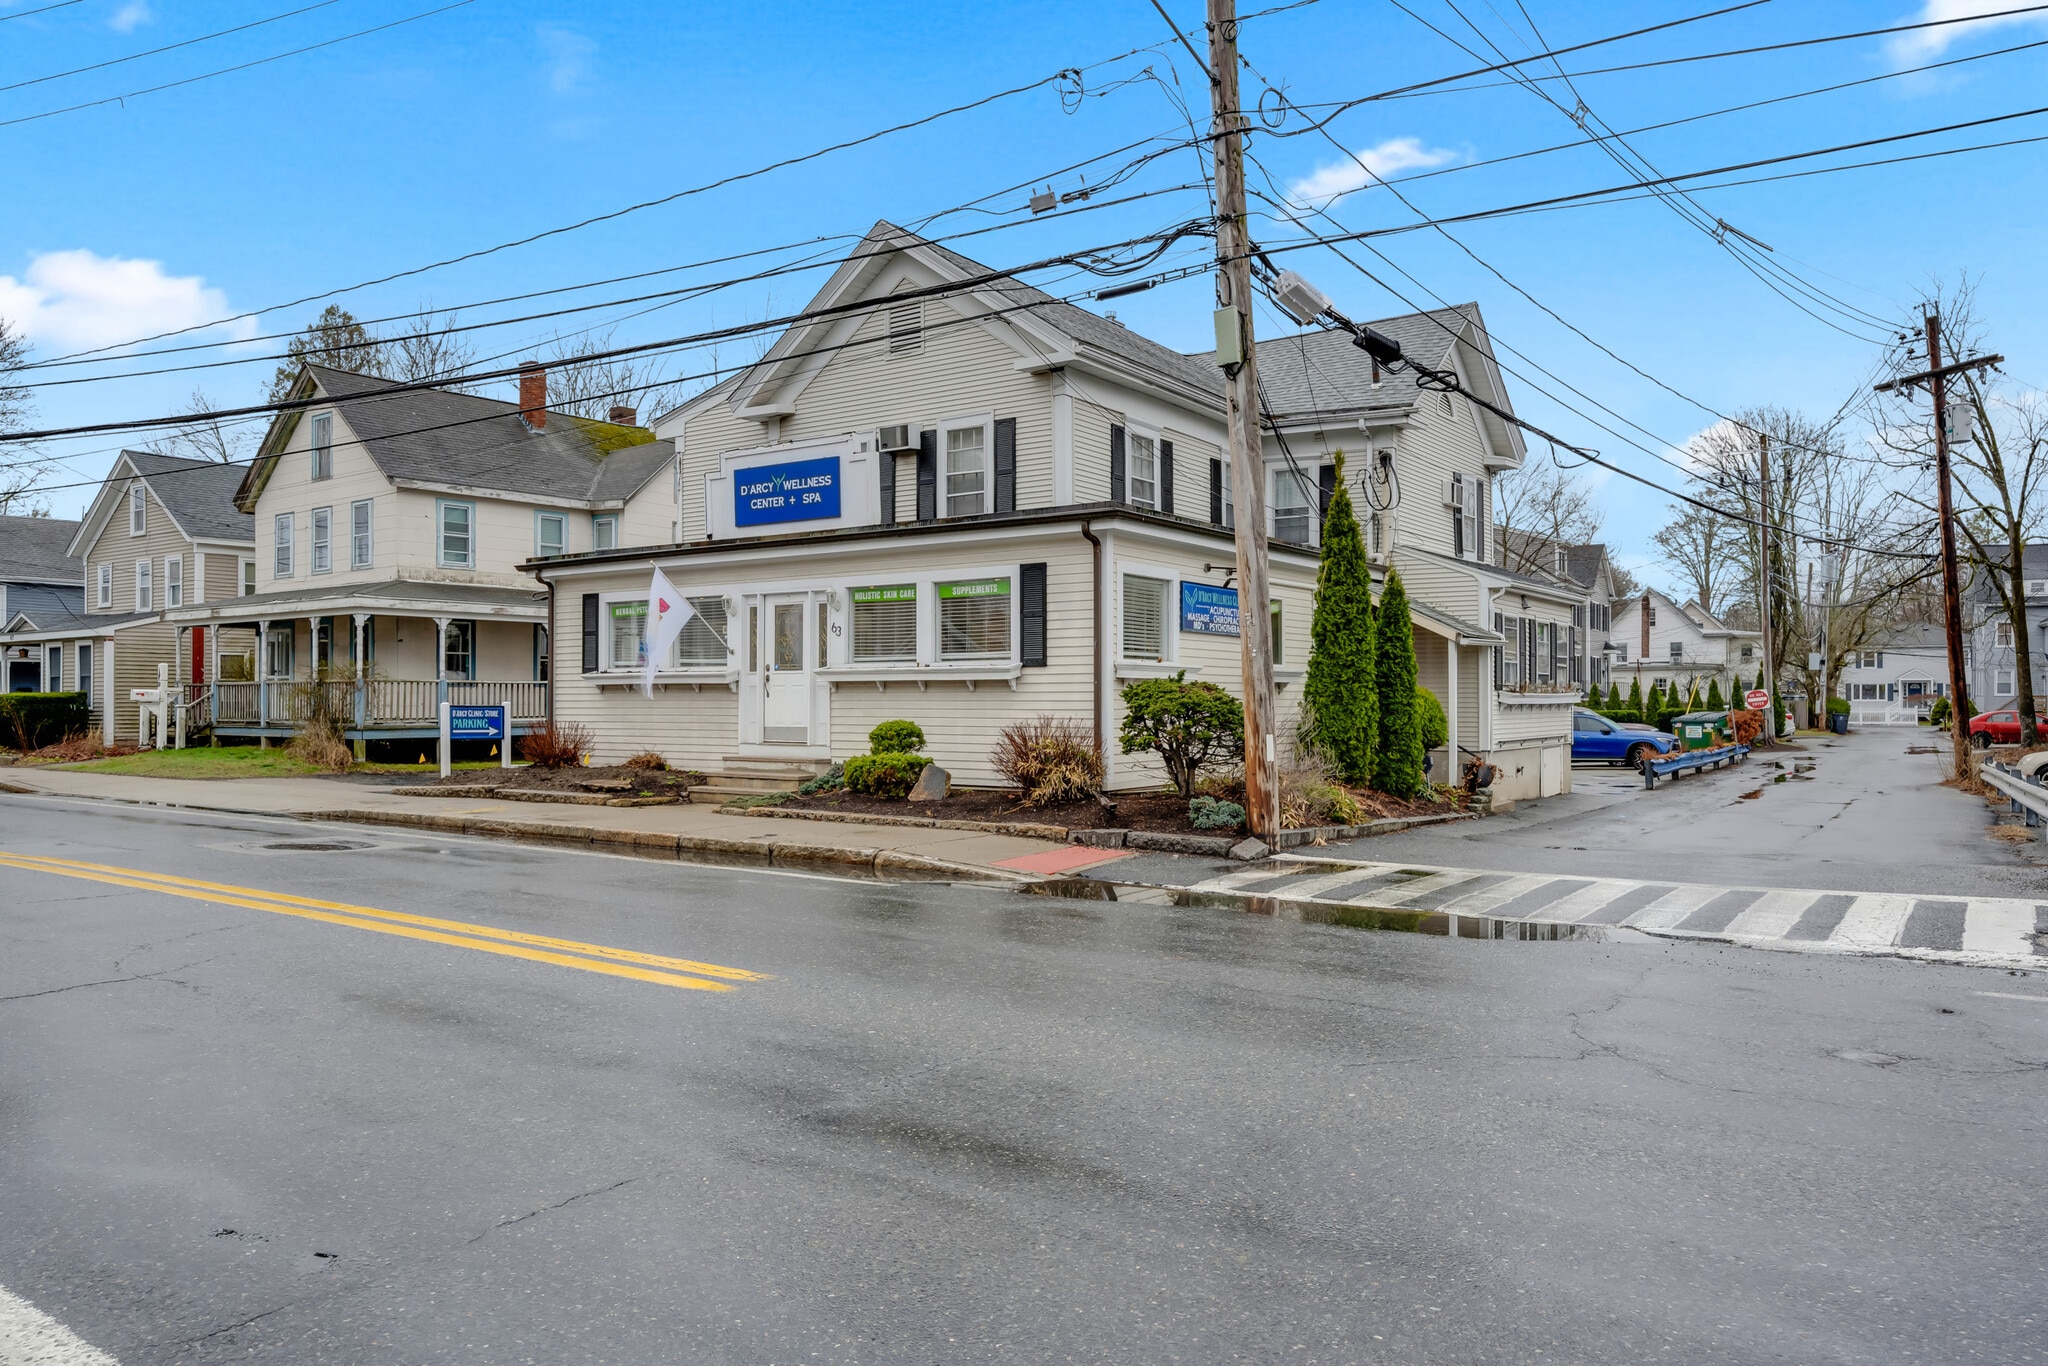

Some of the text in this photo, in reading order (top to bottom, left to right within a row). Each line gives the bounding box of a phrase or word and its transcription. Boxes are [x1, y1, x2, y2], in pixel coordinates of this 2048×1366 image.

[741, 475, 832, 496] D'ARCY WELLNESS
[750, 496, 784, 509] CENTER
[802, 492, 822, 504] SPA
[854, 589, 915, 600] HOLISTIC SKIN CARE
[952, 584, 998, 596] SUPPLEMENTS
[1209, 606, 1239, 617] ACUPUNCTU
[1187, 612, 1240, 626] MASSAGE CHIROPRAC
[831, 622, 842, 637] 63
[1209, 622, 1240, 633] PSYCHOTHERA
[453, 718, 489, 728] PARKING
